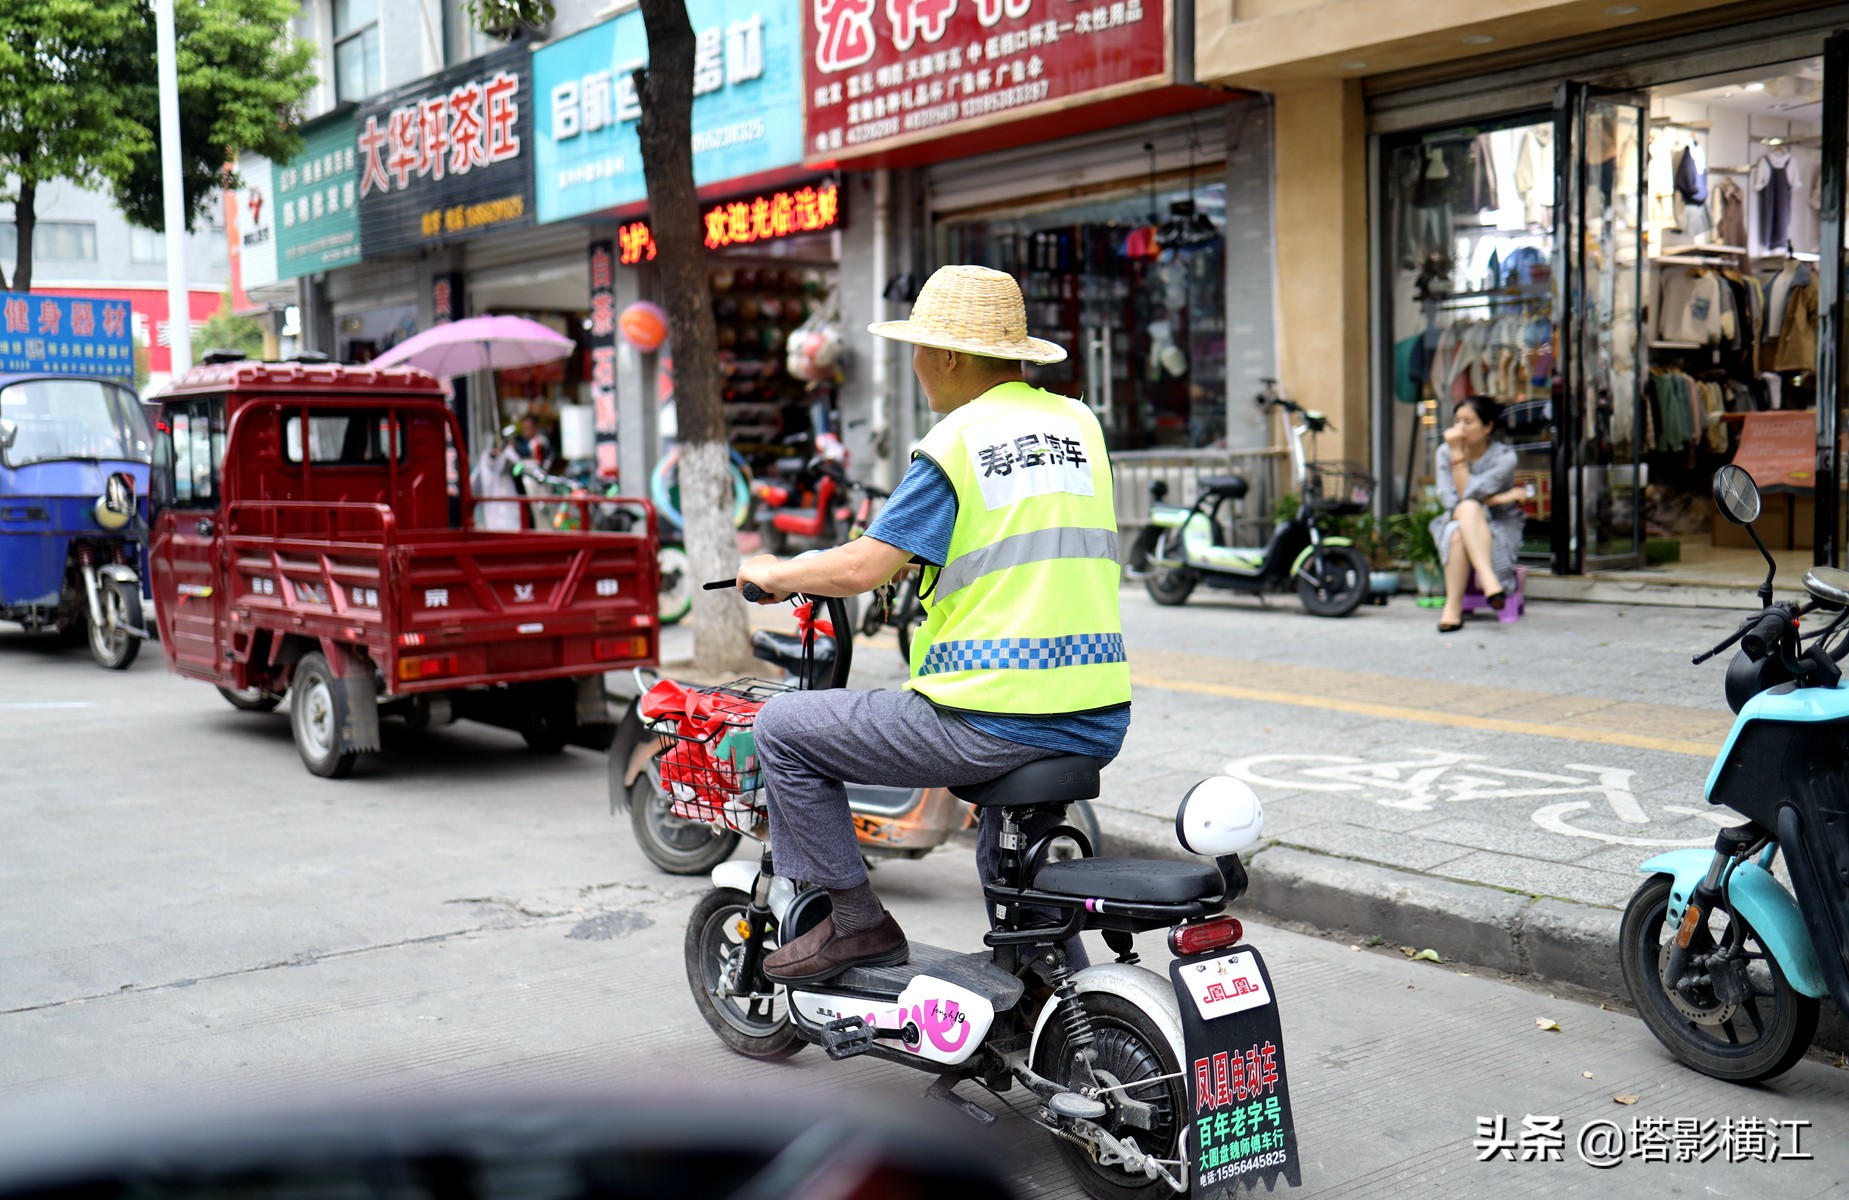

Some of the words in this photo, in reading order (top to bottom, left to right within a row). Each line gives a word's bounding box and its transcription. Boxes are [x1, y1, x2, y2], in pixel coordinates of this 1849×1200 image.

[358, 70, 520, 200] 大华坪茶庄
[4, 296, 126, 338] 健身器材
[1194, 1040, 1280, 1115] 凤凰电动车
[1197, 1096, 1282, 1149] 百年老字号
